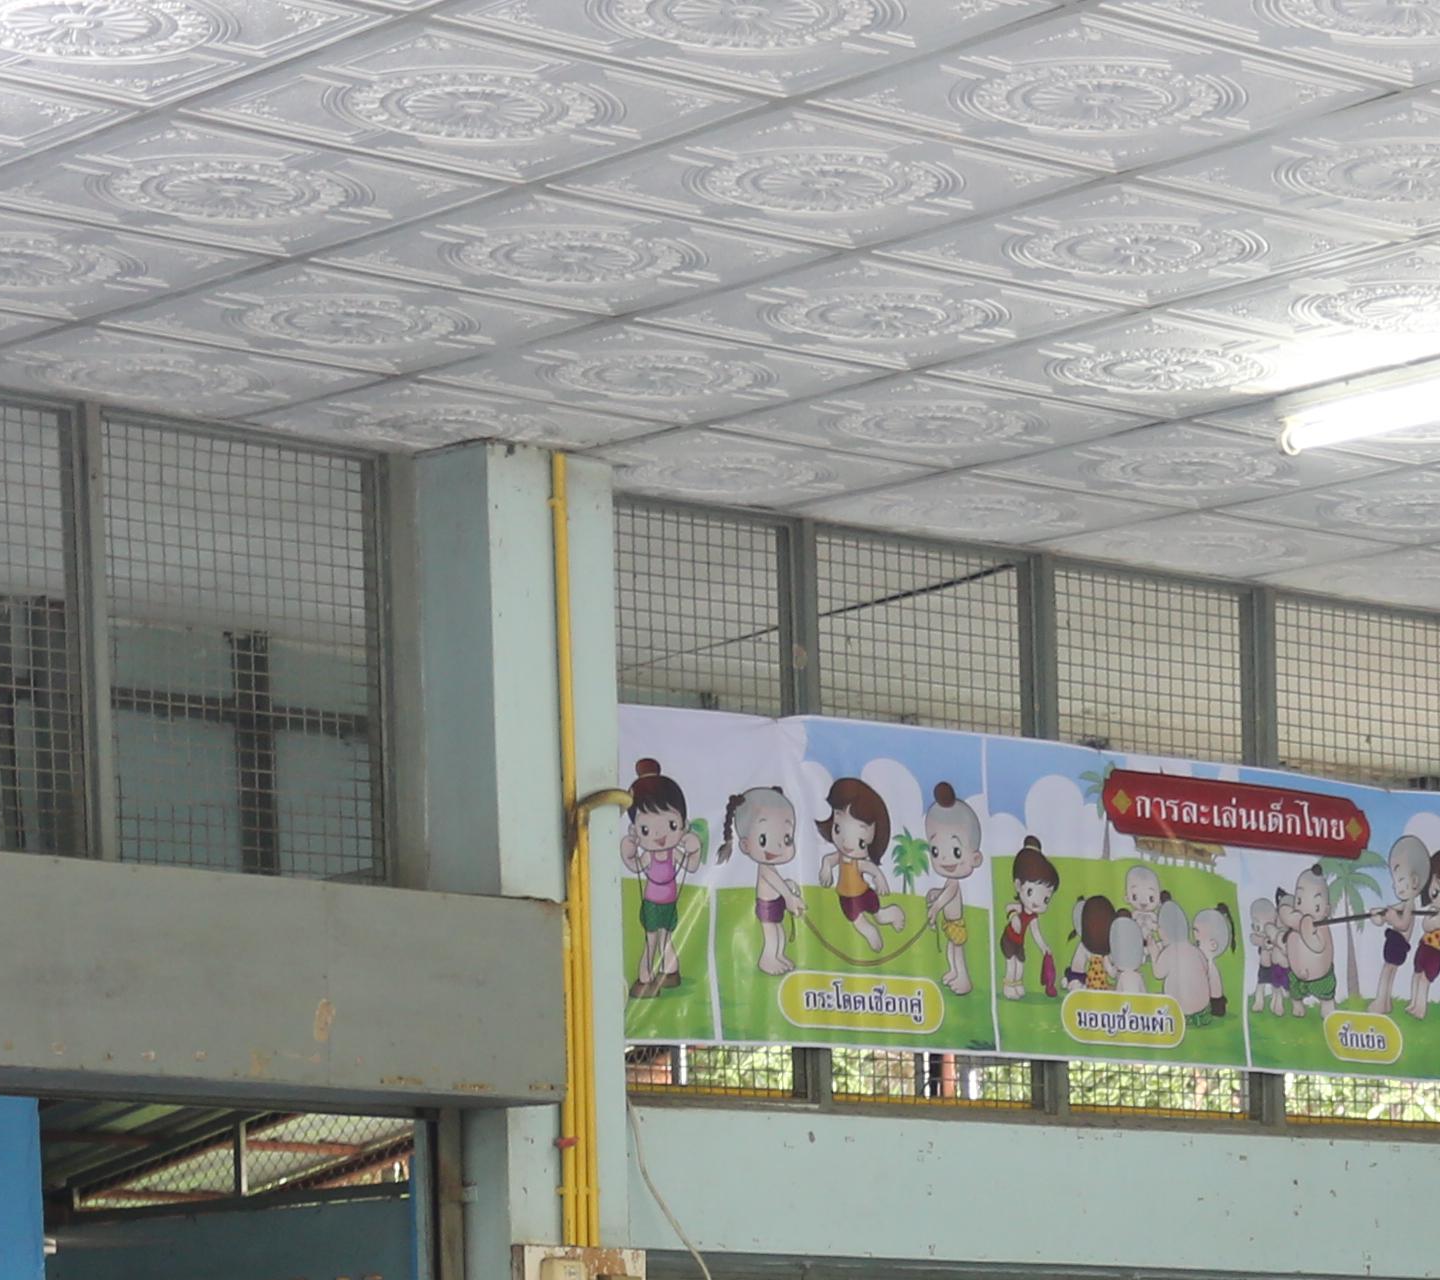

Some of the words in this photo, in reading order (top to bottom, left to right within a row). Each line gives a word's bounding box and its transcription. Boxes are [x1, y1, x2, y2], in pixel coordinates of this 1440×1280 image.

[1134, 789, 1346, 841] การละเล่นเด็กไทย
[804, 982, 926, 1025] กระโดดเชือกคู่
[1076, 1005, 1176, 1037] มอญซ่อนผ้า
[1336, 1023, 1387, 1053] ชักเย่อ
